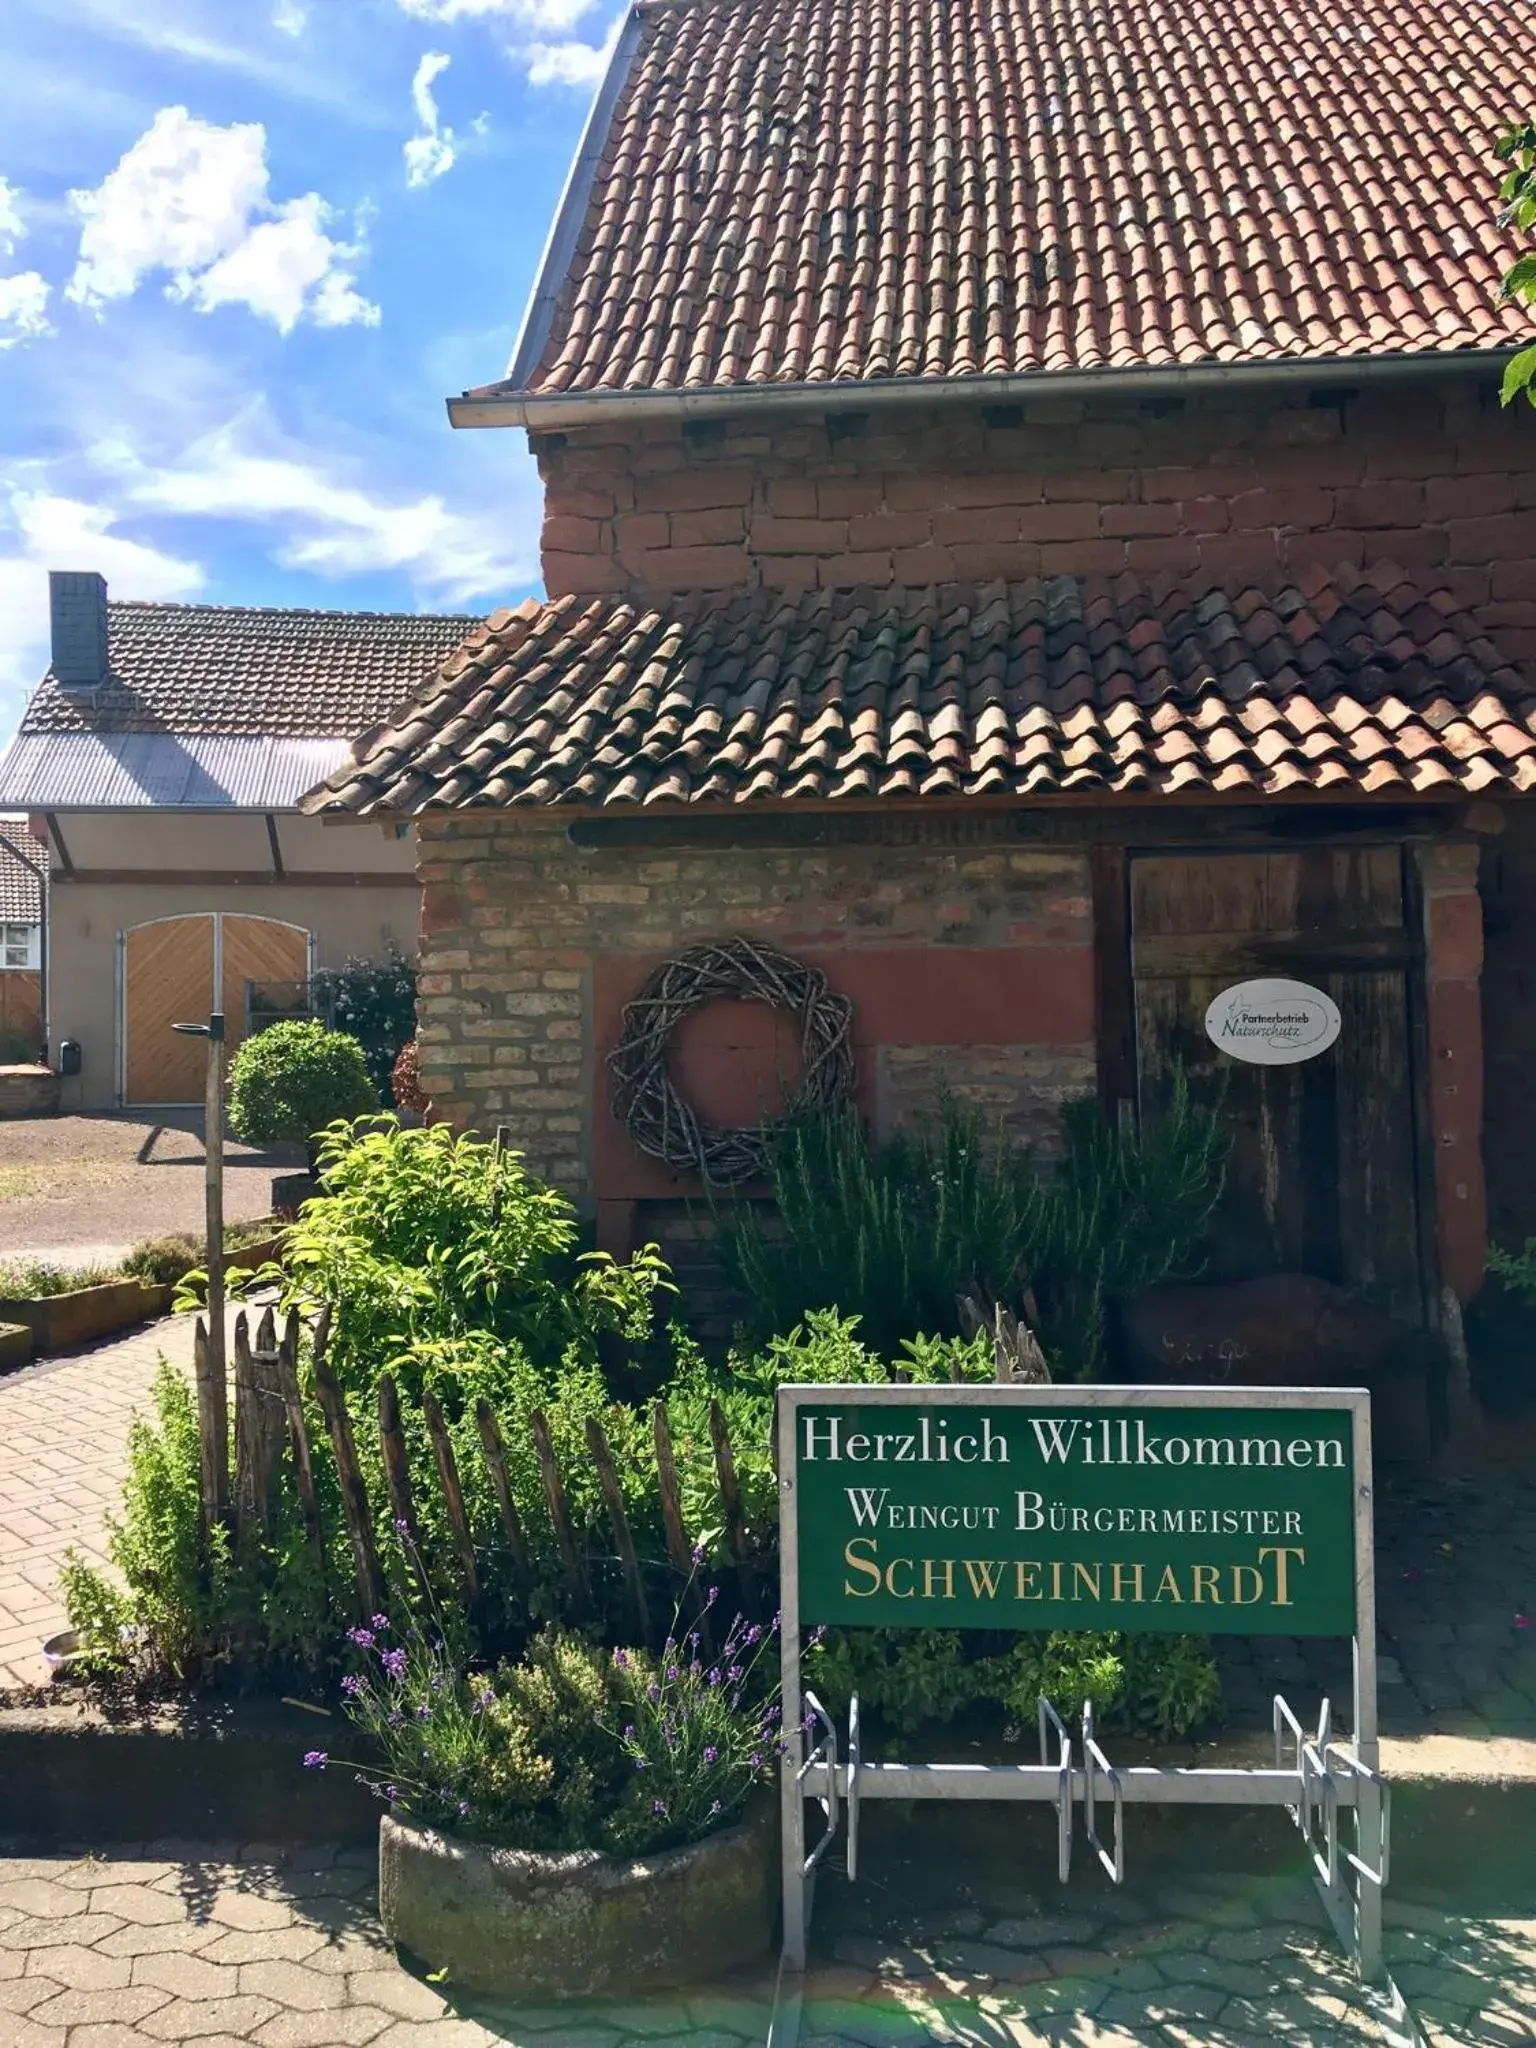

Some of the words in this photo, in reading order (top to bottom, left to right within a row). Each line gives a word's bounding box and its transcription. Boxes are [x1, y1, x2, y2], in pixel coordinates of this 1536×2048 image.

[1221, 1019, 1300, 1037] Naturschutz
[1242, 1012, 1309, 1024] Partnerbetrieb
[802, 1416, 1010, 1462] Herzlich
[1028, 1418, 1346, 1467] Willkommen
[843, 1487, 999, 1529] WEINGUT
[1014, 1491, 1303, 1535] BÜRGERMEISTER
[844, 1537, 1305, 1605] SCHWEINHARDT
